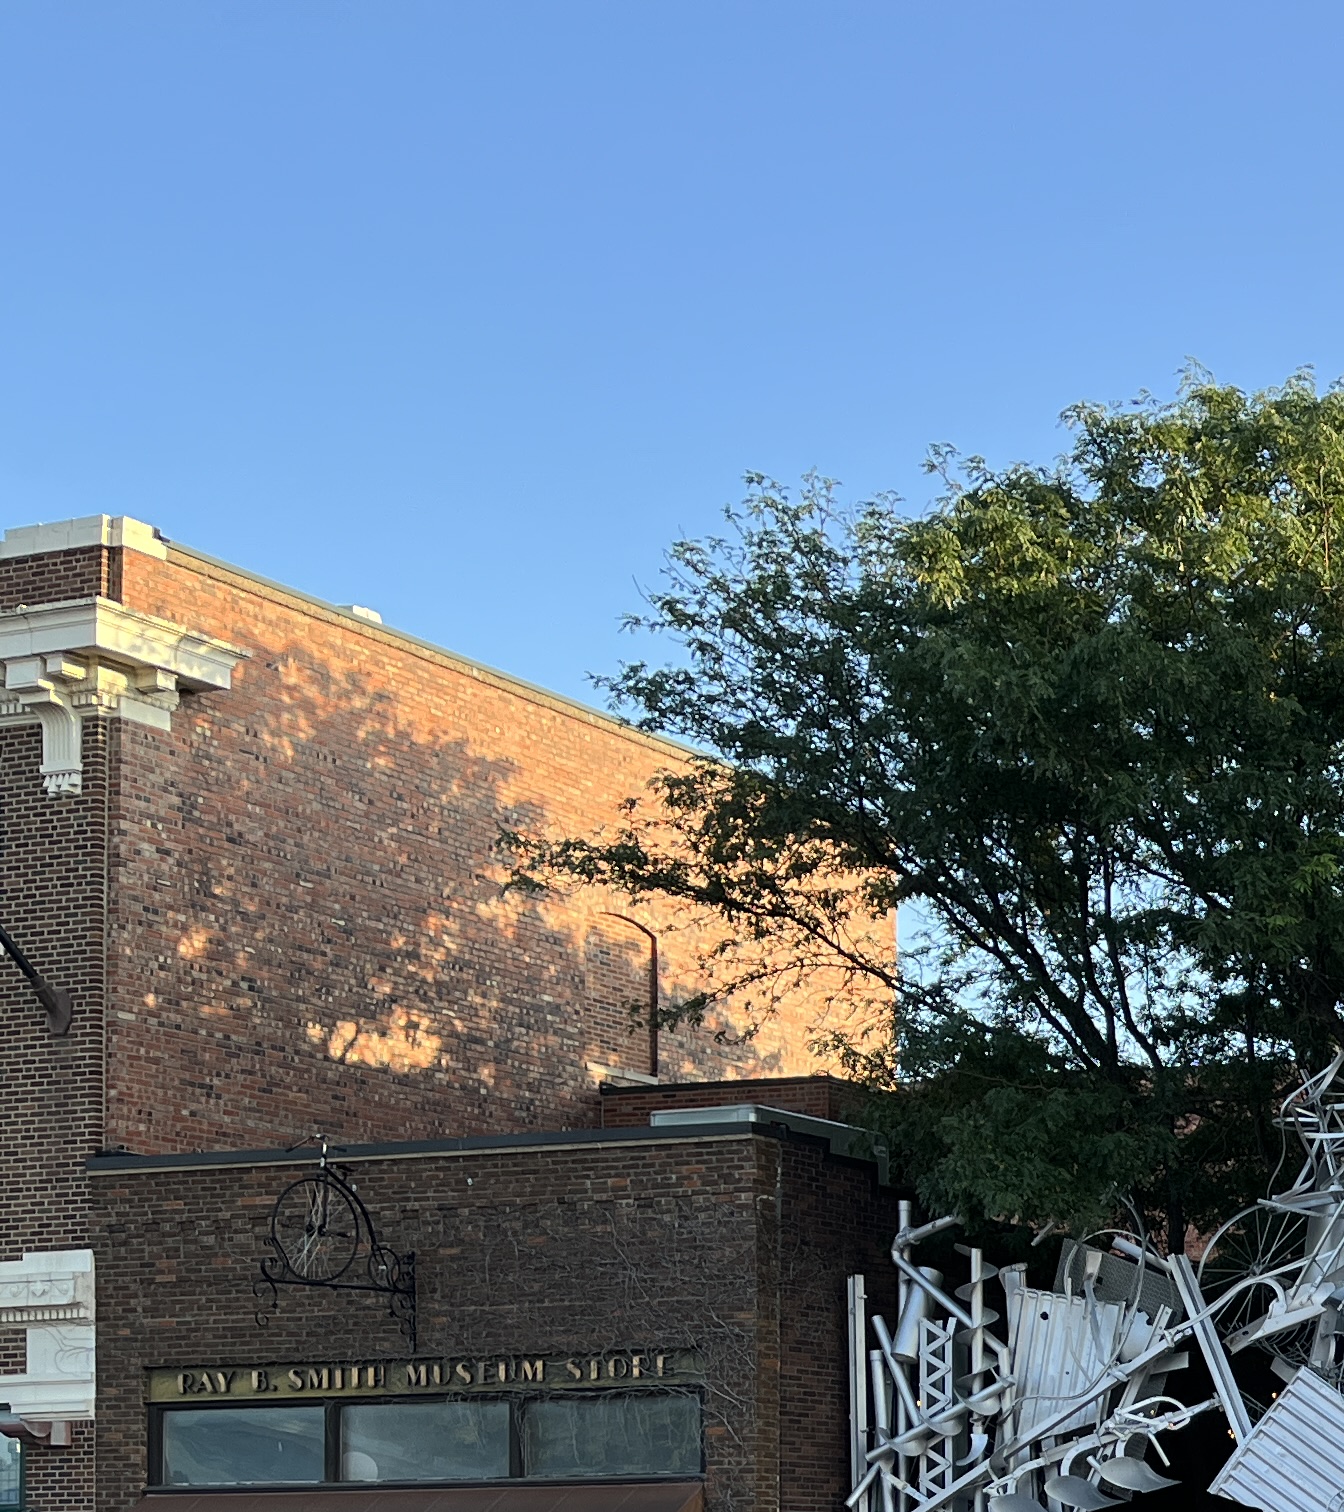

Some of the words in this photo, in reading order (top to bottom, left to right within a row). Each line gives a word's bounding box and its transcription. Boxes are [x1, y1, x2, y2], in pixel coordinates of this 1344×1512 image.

[177, 1370, 235, 1395] RAY
[251, 1368, 277, 1392] B.
[288, 1364, 386, 1391] SMITH
[406, 1358, 545, 1387] MUSEUM
